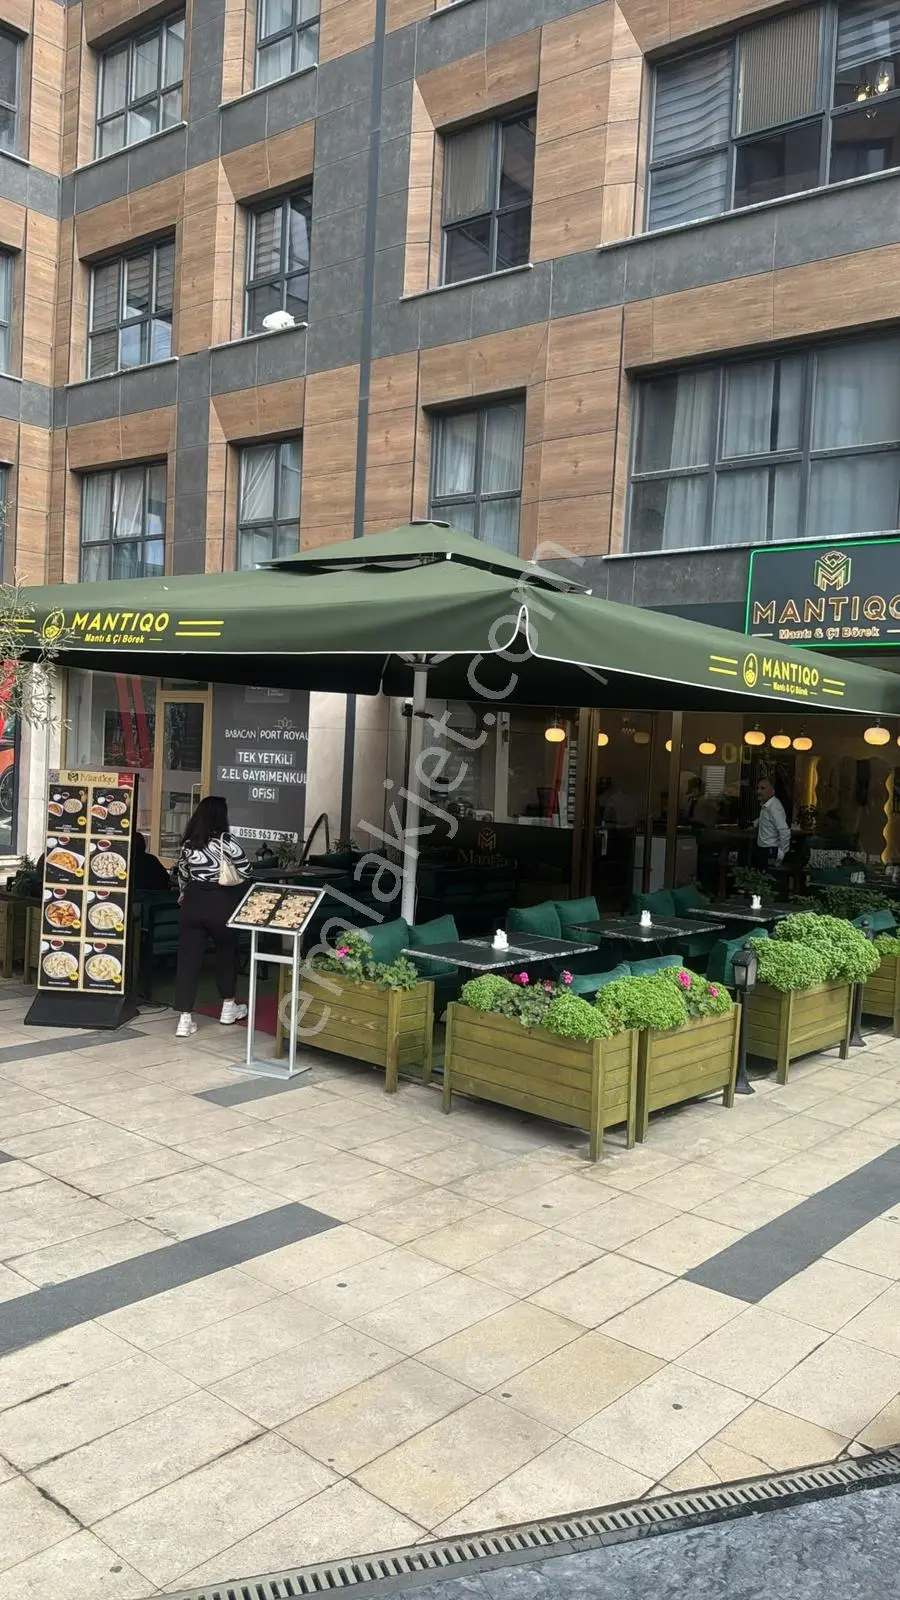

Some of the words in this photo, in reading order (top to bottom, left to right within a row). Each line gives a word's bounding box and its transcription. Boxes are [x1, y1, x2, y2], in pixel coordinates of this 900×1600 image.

[72, 612, 170, 632] MANTIQO
[105, 634, 112, 643] &
[122, 634, 145, 644] Börek
[814, 628, 824, 639] &
[841, 626, 880, 638] Börek
[762, 657, 819, 687] MANTIQO
[224, 728, 257, 740] BABACAN
[259, 730, 281, 741] PORT
[238, 751, 256, 763] TEK
[221, 768, 241, 781] 2.EL
[239, 827, 257, 838] 0555
